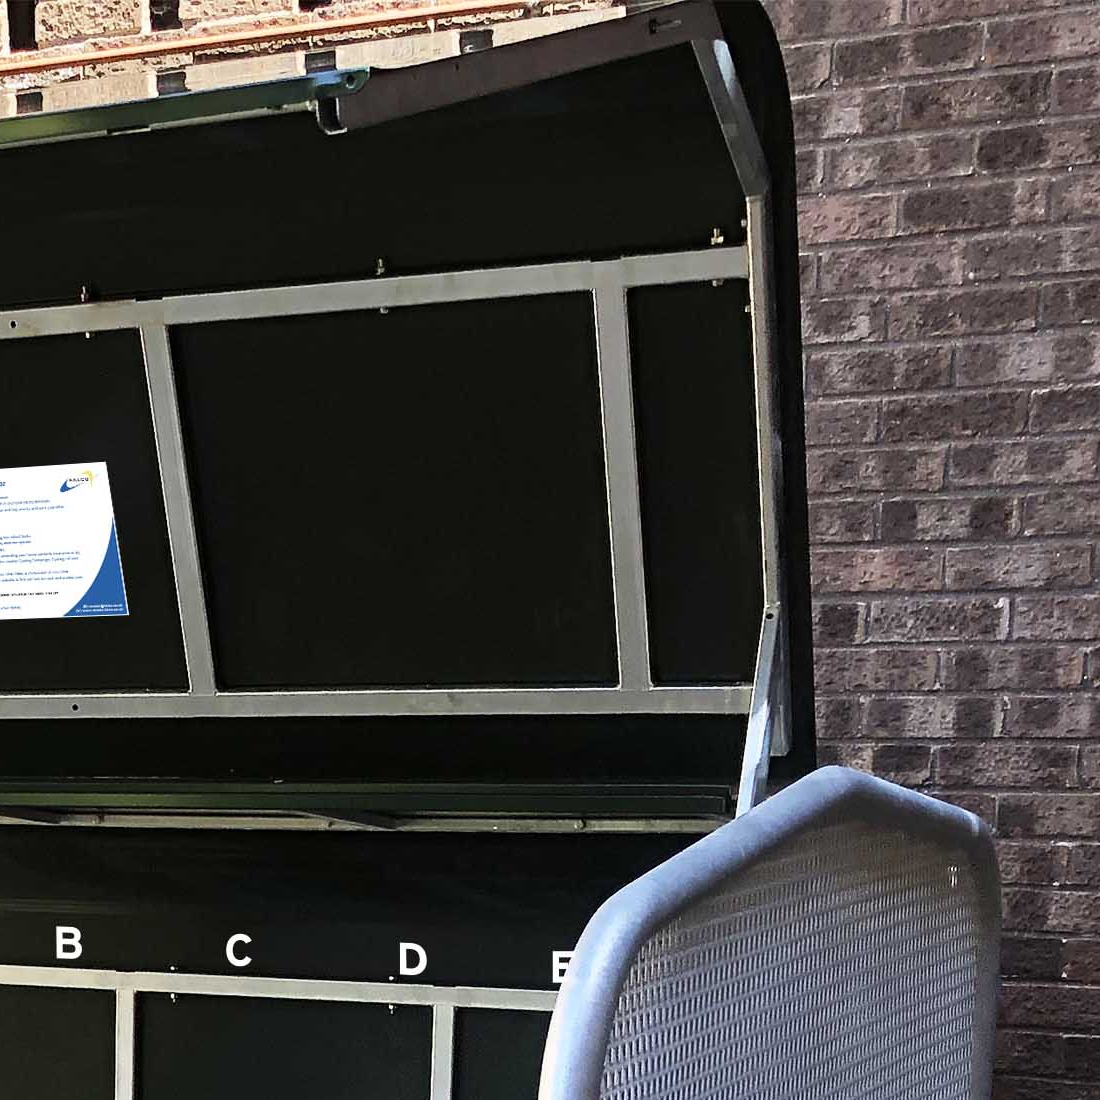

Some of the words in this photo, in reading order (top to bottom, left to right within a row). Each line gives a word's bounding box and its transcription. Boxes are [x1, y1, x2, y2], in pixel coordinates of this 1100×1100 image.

[55, 926, 83, 959] B
[225, 933, 253, 967] C
[399, 943, 428, 976] D
[552, 950, 574, 983] E
